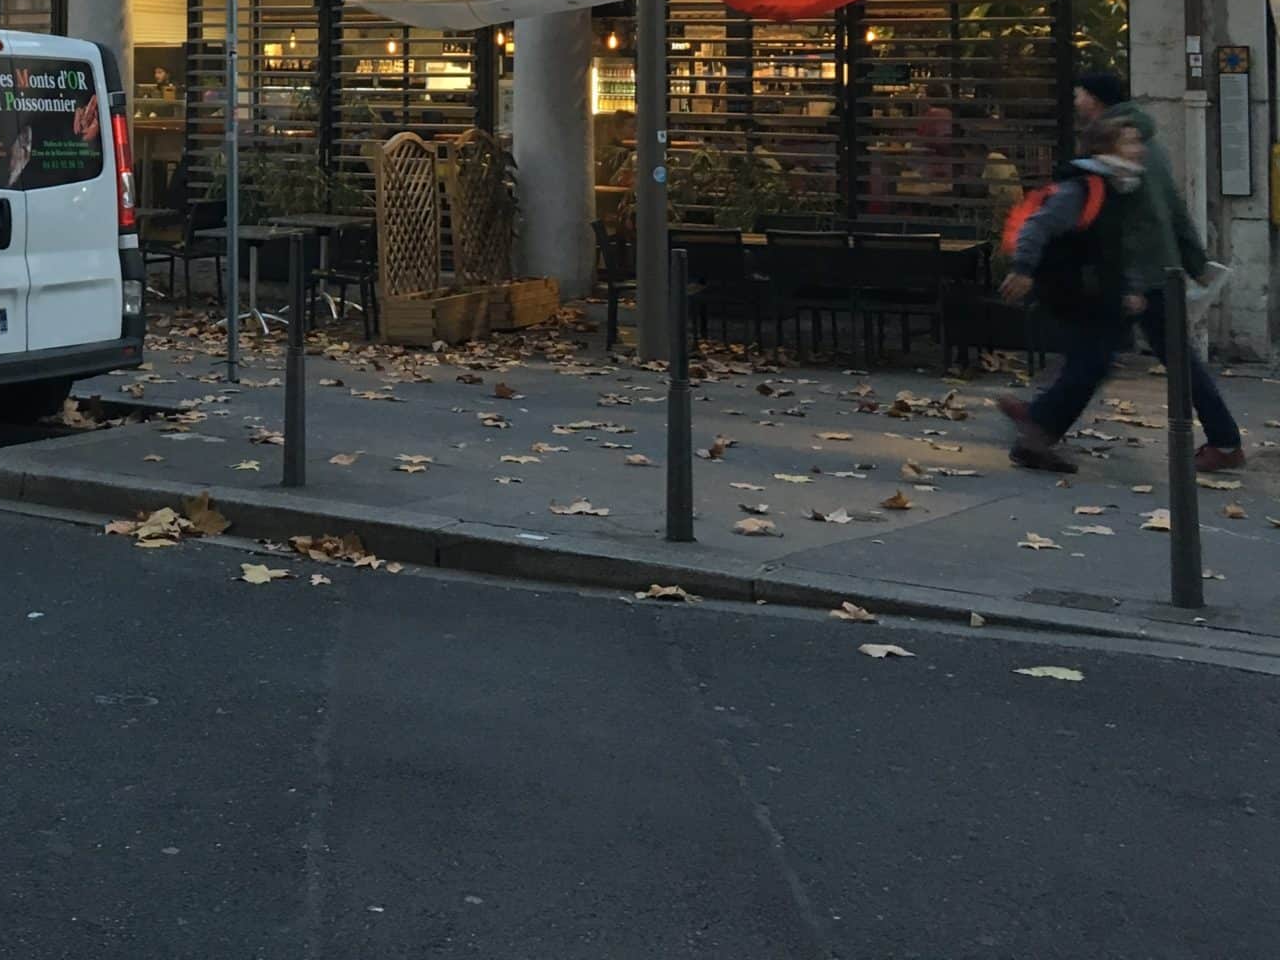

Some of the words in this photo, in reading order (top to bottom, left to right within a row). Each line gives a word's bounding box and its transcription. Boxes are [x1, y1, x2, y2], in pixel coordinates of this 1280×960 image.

[15, 68, 56, 90] Monts
[57, 69, 88, 91] d'OR
[3, 90, 77, 113] Poissonnier
